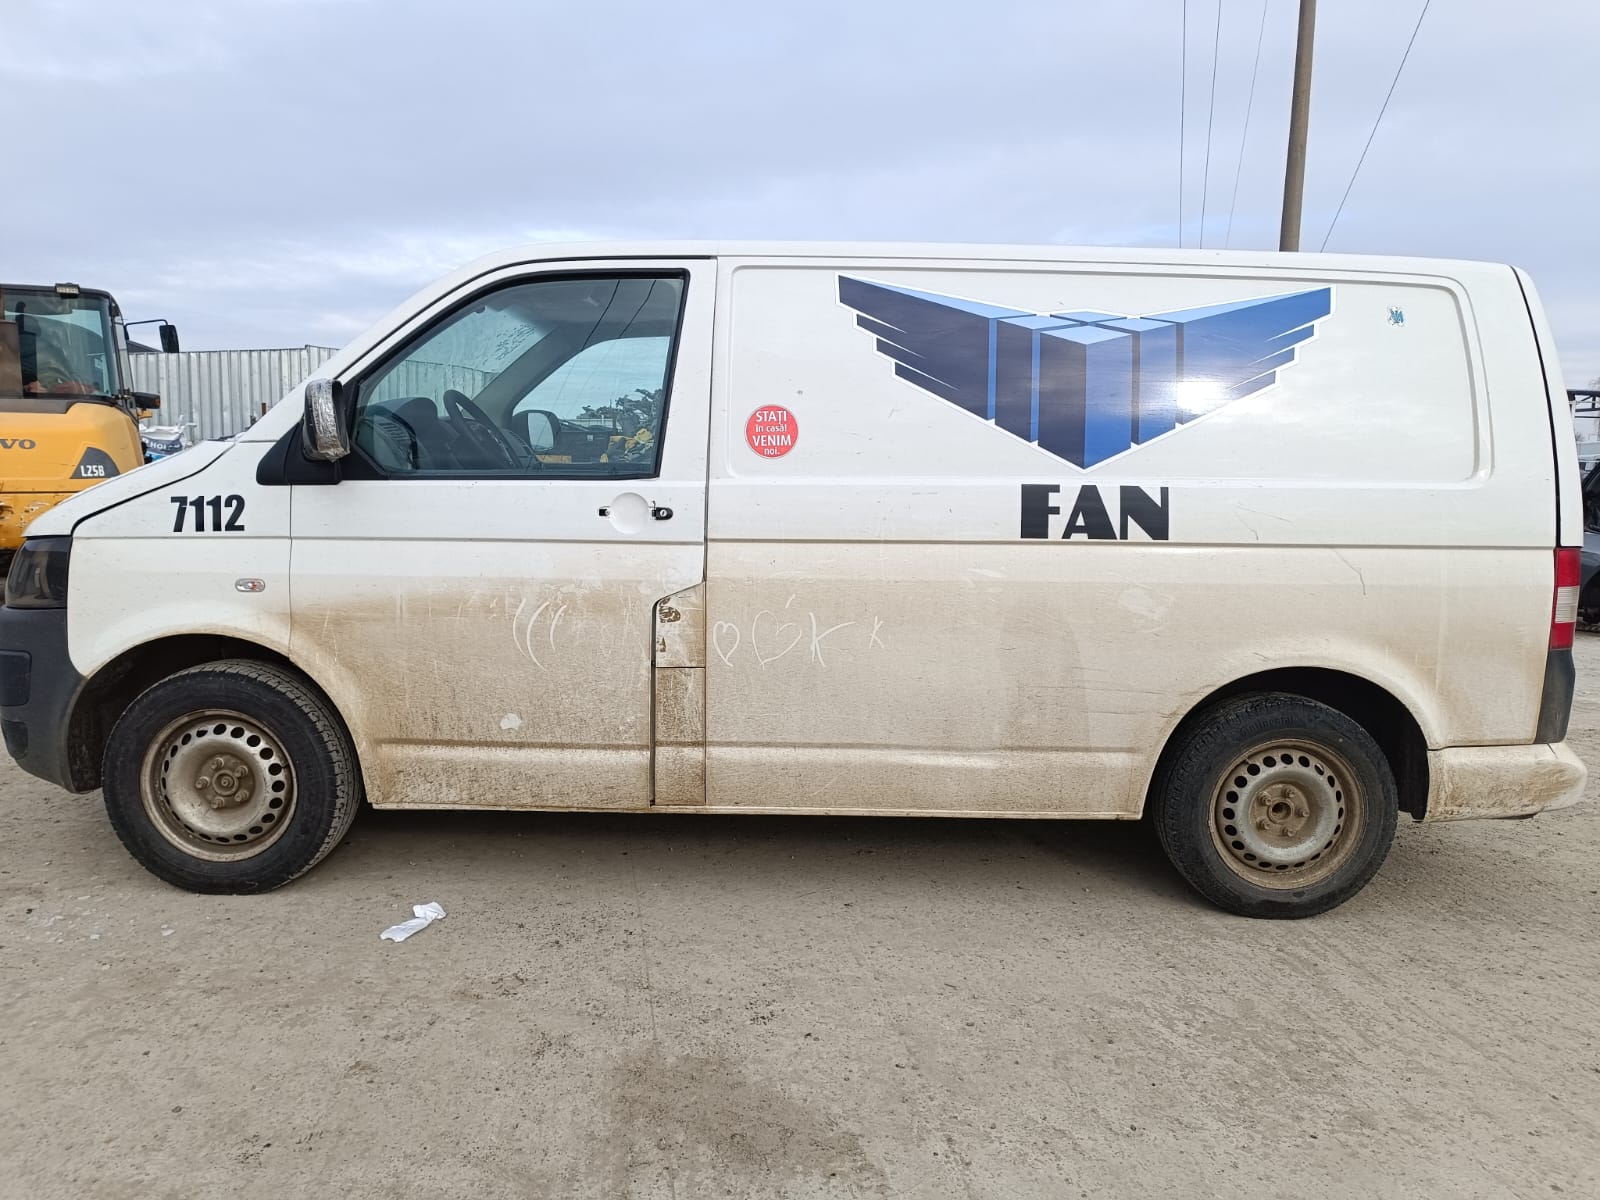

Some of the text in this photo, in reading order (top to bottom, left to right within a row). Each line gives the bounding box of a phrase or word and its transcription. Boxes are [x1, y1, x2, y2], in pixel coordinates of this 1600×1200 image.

[752, 434, 792, 447] VENIM
[80, 465, 105, 477] L25B
[170, 494, 246, 533] 7112
[1020, 483, 1170, 541] FAN
